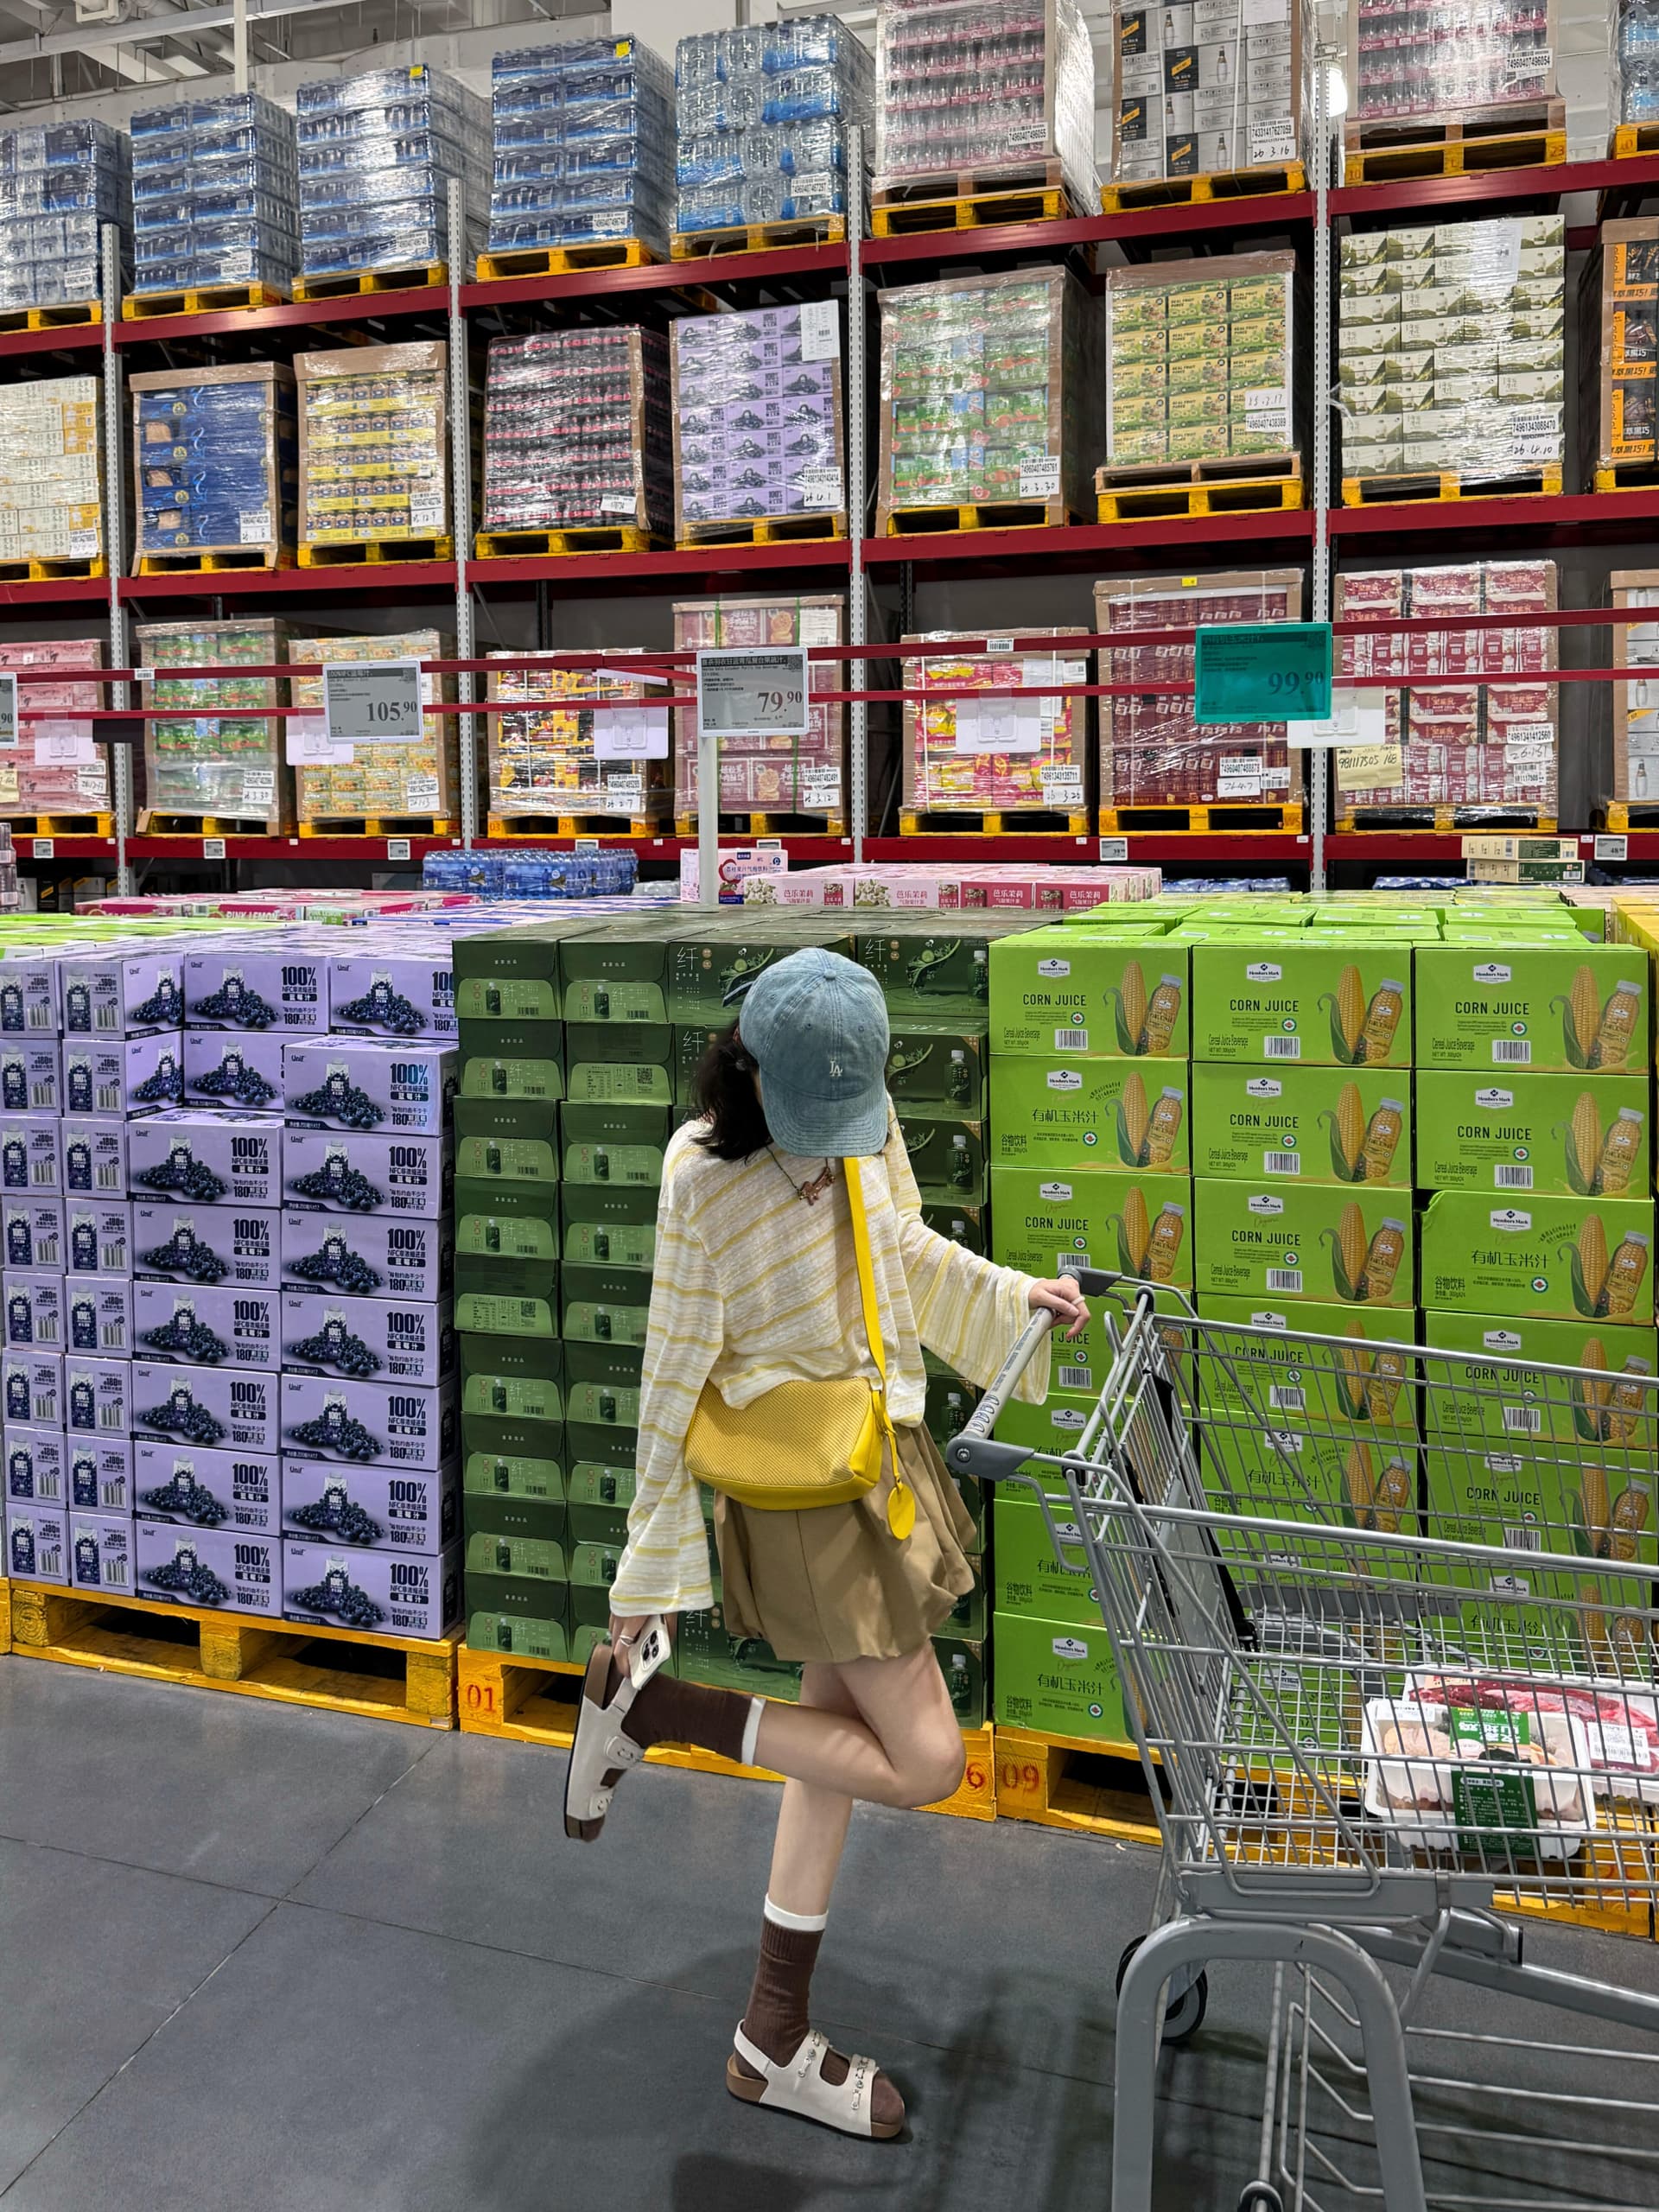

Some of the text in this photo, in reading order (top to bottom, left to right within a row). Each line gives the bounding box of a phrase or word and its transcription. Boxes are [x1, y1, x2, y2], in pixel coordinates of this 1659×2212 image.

[282, 967, 316, 986] 100%
[1023, 995, 1086, 1006] CORN JUICE
[1230, 1000, 1299, 1012] CORN JUICE
[1456, 1002, 1529, 1014] CORN JUICE
[283, 1014, 299, 1025] 180
[391, 1064, 428, 1087] 100%
[391, 1112, 409, 1127] 180
[1032, 1109, 1099, 1123] 有机玉米汁
[1230, 1114, 1299, 1128] CORN JUICE
[1458, 1126, 1531, 1140] CORN JUICE
[231, 1137, 267, 1160] 100%
[390, 1147, 426, 1170] 100%
[233, 1185, 249, 1199] 180
[391, 1194, 407, 1209] 180
[233, 1219, 269, 1240] 100%
[1026, 1217, 1088, 1230] CORN JUICE
[388, 1229, 425, 1253] 100%
[1232, 1230, 1300, 1246] CORN JUICE
[1471, 1250, 1550, 1268] 有机玉米汁
[236, 1267, 251, 1281] 180
[389, 1276, 405, 1291] 180
[233, 1300, 269, 1323] 100%
[387, 1313, 424, 1336] 100%
[236, 1348, 251, 1362] 180
[388, 1360, 405, 1375] 180
[230, 1382, 265, 1405] 100%
[388, 1396, 425, 1420] 100%
[232, 1430, 248, 1444] 180
[390, 1444, 406, 1459] 180
[232, 1464, 267, 1487] 100%
[389, 1480, 426, 1504] 100%
[235, 1512, 251, 1525] 180
[391, 1528, 407, 1542] 180
[234, 1544, 270, 1567] 100%
[391, 1564, 428, 1587] 100%
[236, 1592, 252, 1605] 180
[391, 1611, 408, 1625] 180
[1037, 1674, 1104, 1696] 有机玉米汁
[467, 1685, 495, 1713] 01
[1002, 1764, 1039, 1791] 09
